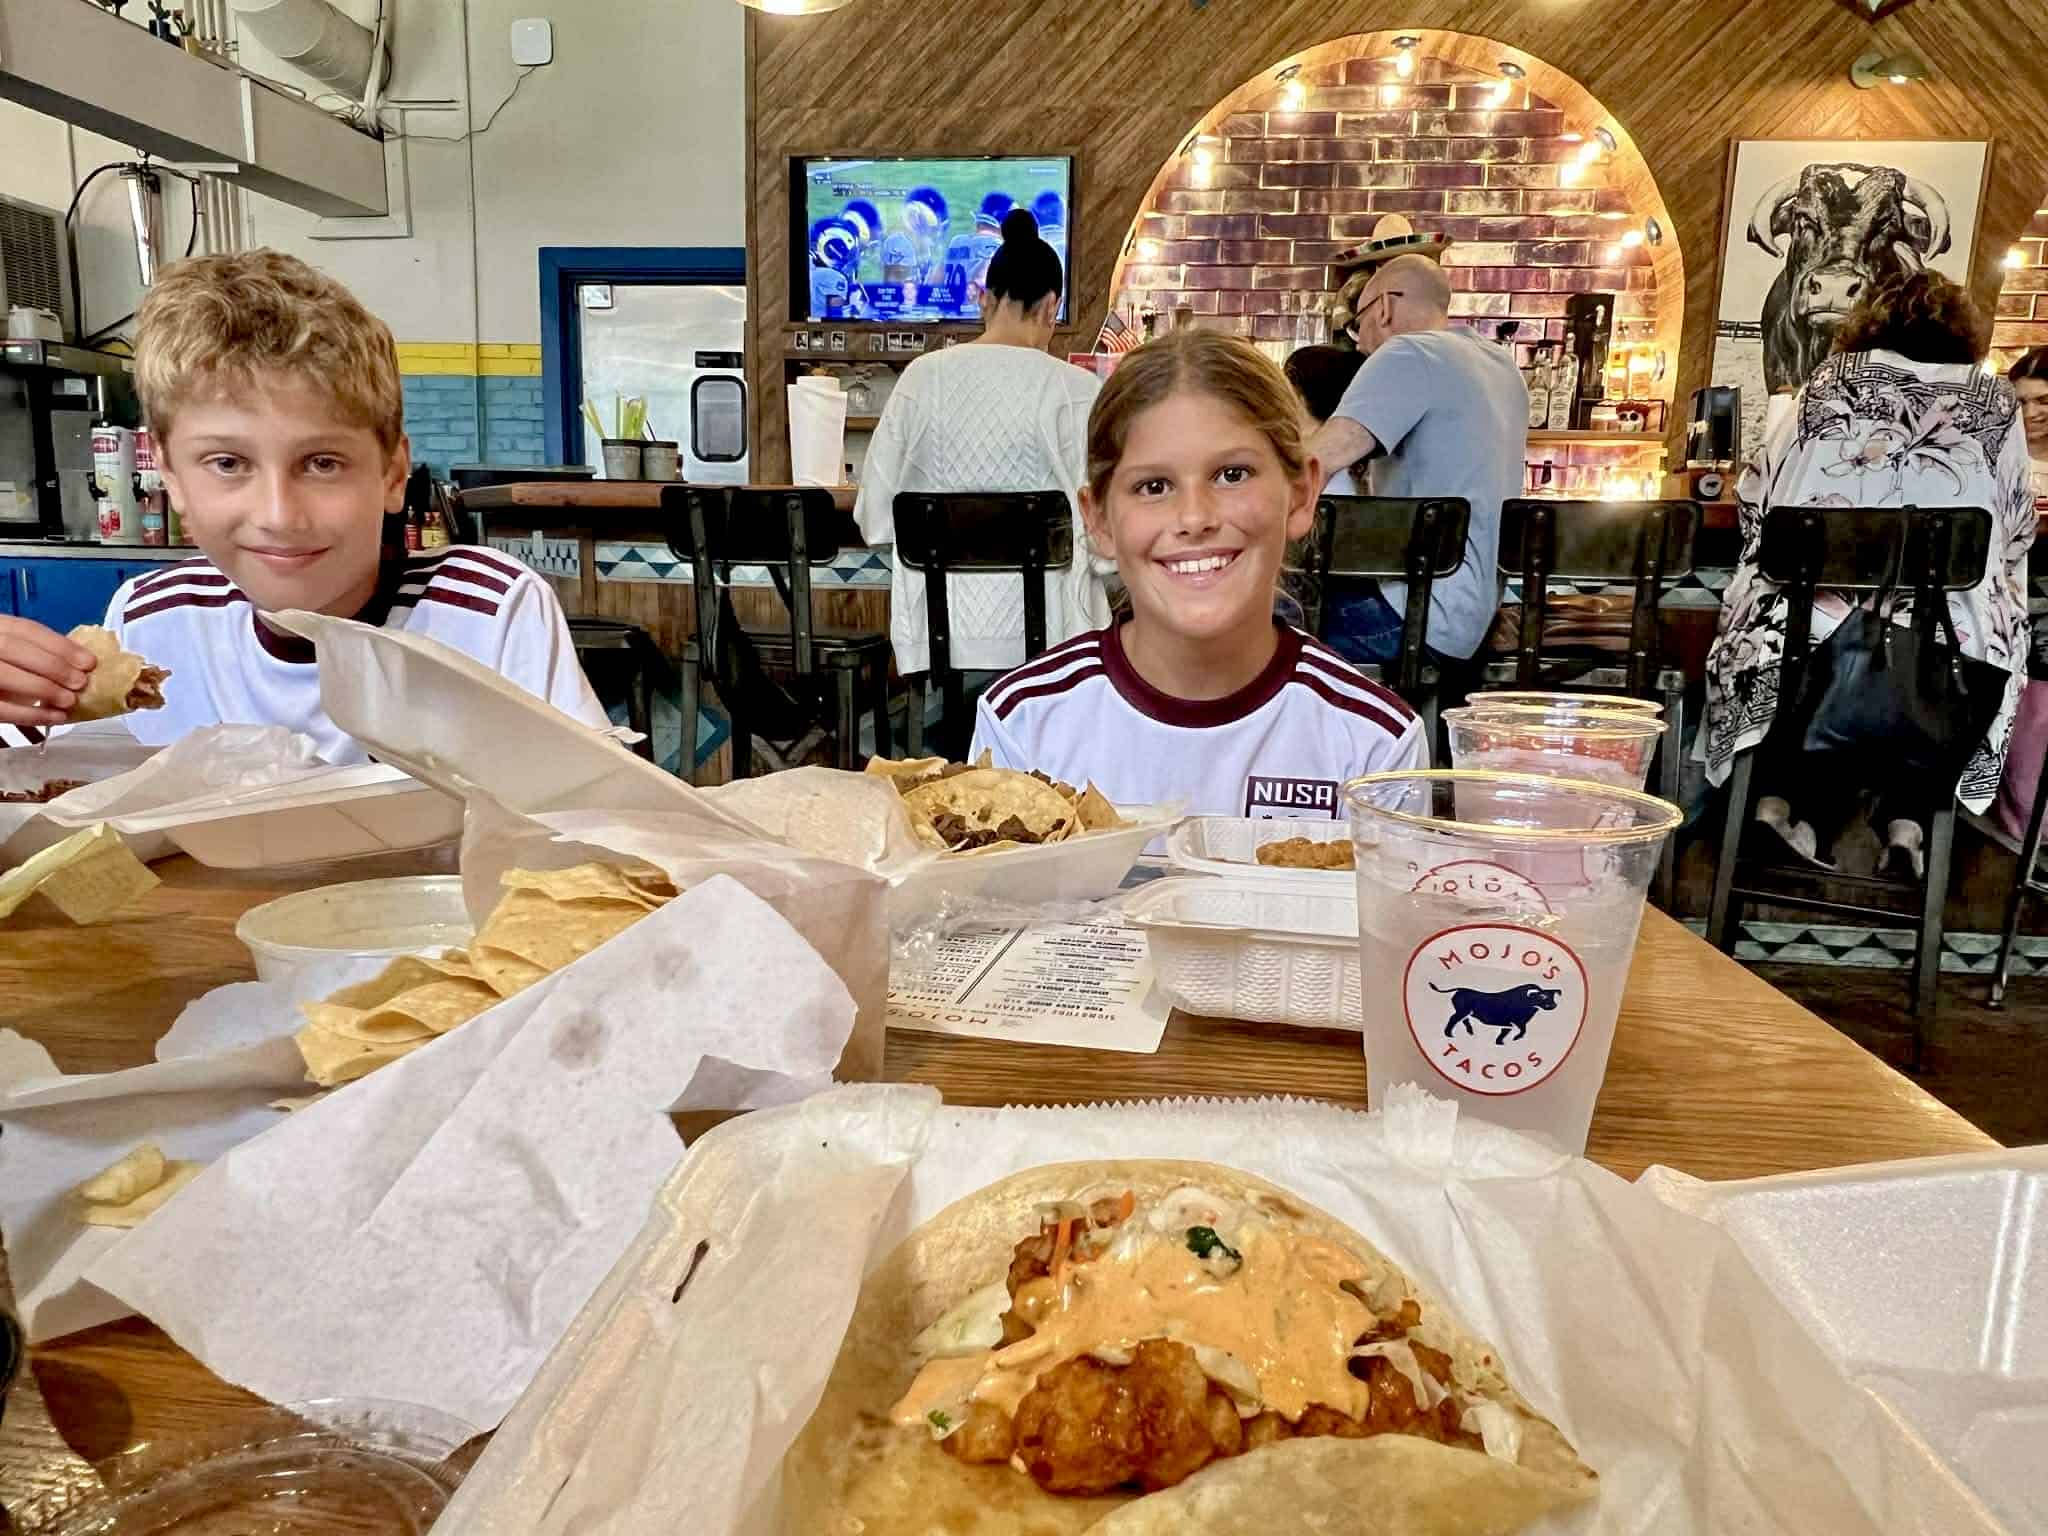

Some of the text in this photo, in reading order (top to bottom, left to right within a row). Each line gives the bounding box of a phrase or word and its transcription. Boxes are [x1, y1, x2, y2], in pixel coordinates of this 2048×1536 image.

[1254, 781, 1333, 806] NUSA
[1437, 942, 1561, 981] MOJO'S
[1441, 1042, 1542, 1080] TACOS
